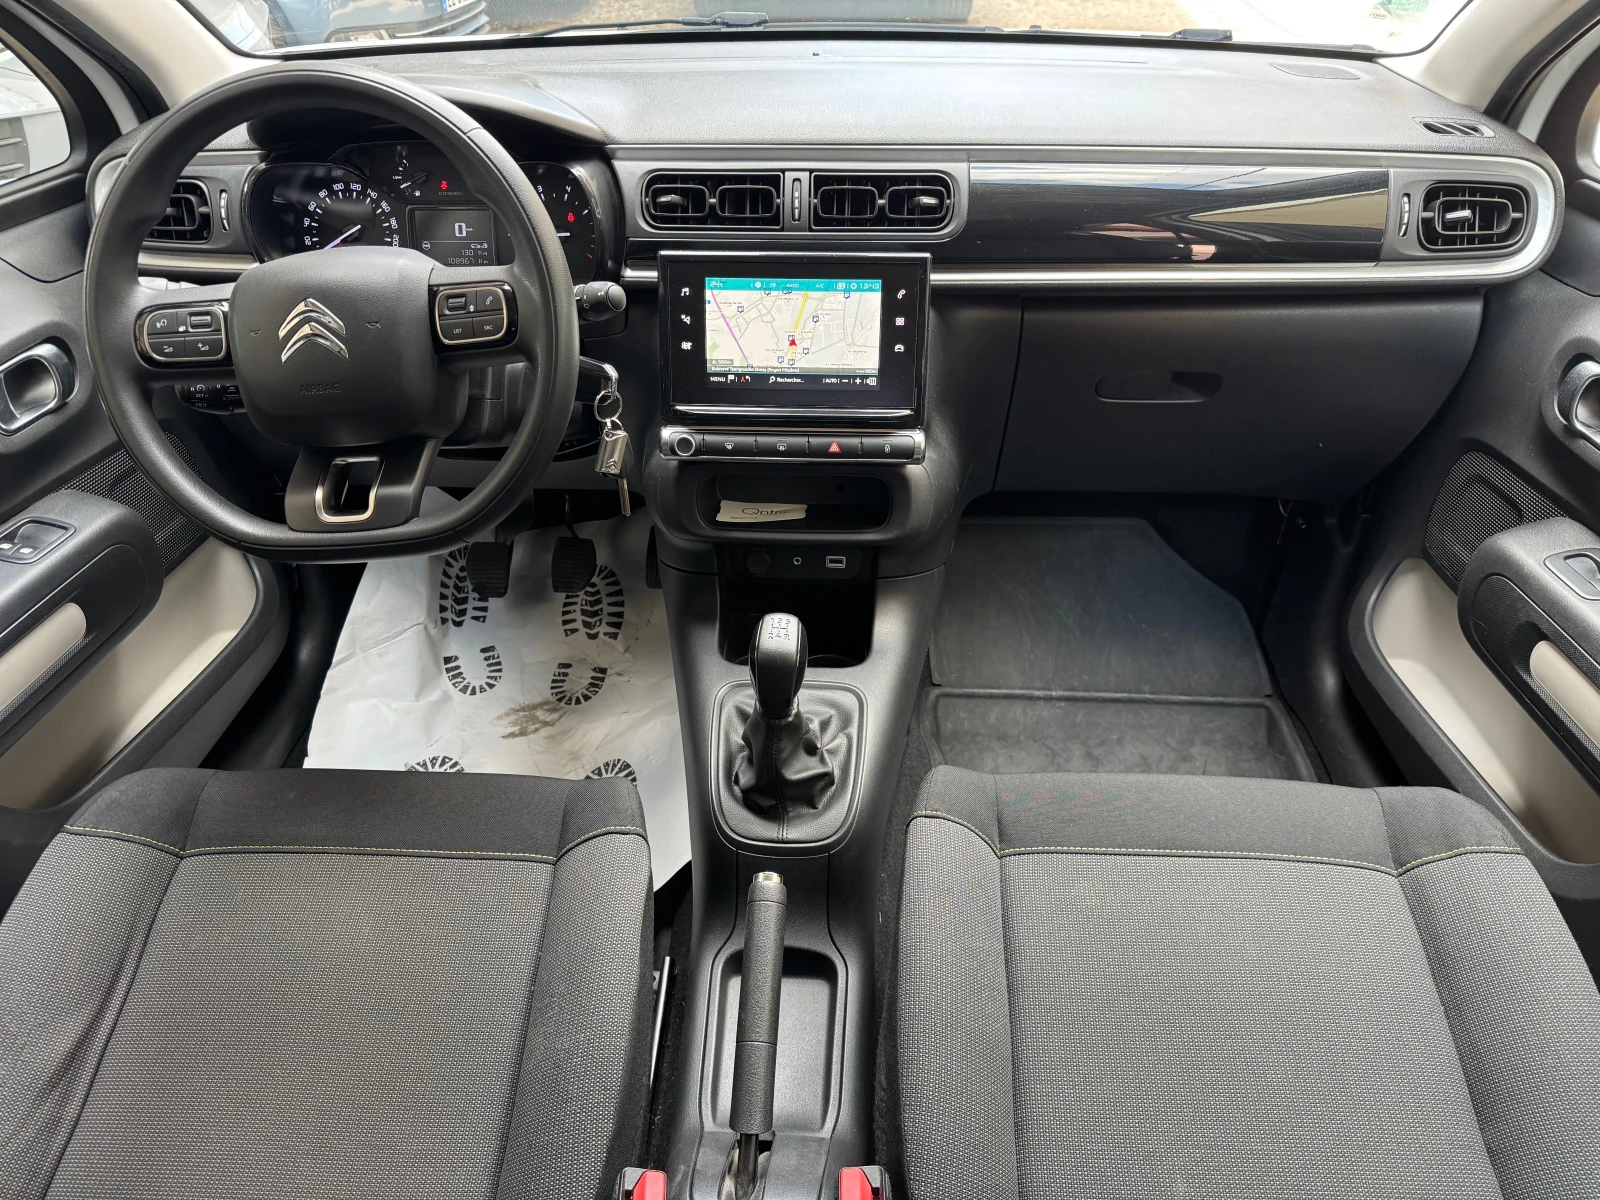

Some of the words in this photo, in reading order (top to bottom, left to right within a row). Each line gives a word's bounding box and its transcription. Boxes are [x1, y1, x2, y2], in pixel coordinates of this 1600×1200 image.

[332, 183, 345, 191] 100
[350, 183, 361, 191] 120
[537, 185, 543, 193] 3
[565, 185, 571, 193] 4
[318, 189, 328, 198] 80
[366, 188, 378, 199] 140
[308, 201, 317, 212] 60
[380, 200, 391, 213] 160
[303, 218, 310, 227] 40
[390, 217, 398, 229] 180
[455, 222, 467, 237] 0
[304, 235, 312, 246] 20
[448, 257, 475, 265] 108967
[859, 282, 880, 290] 13:43
[299, 382, 342, 395] AIRBAG
